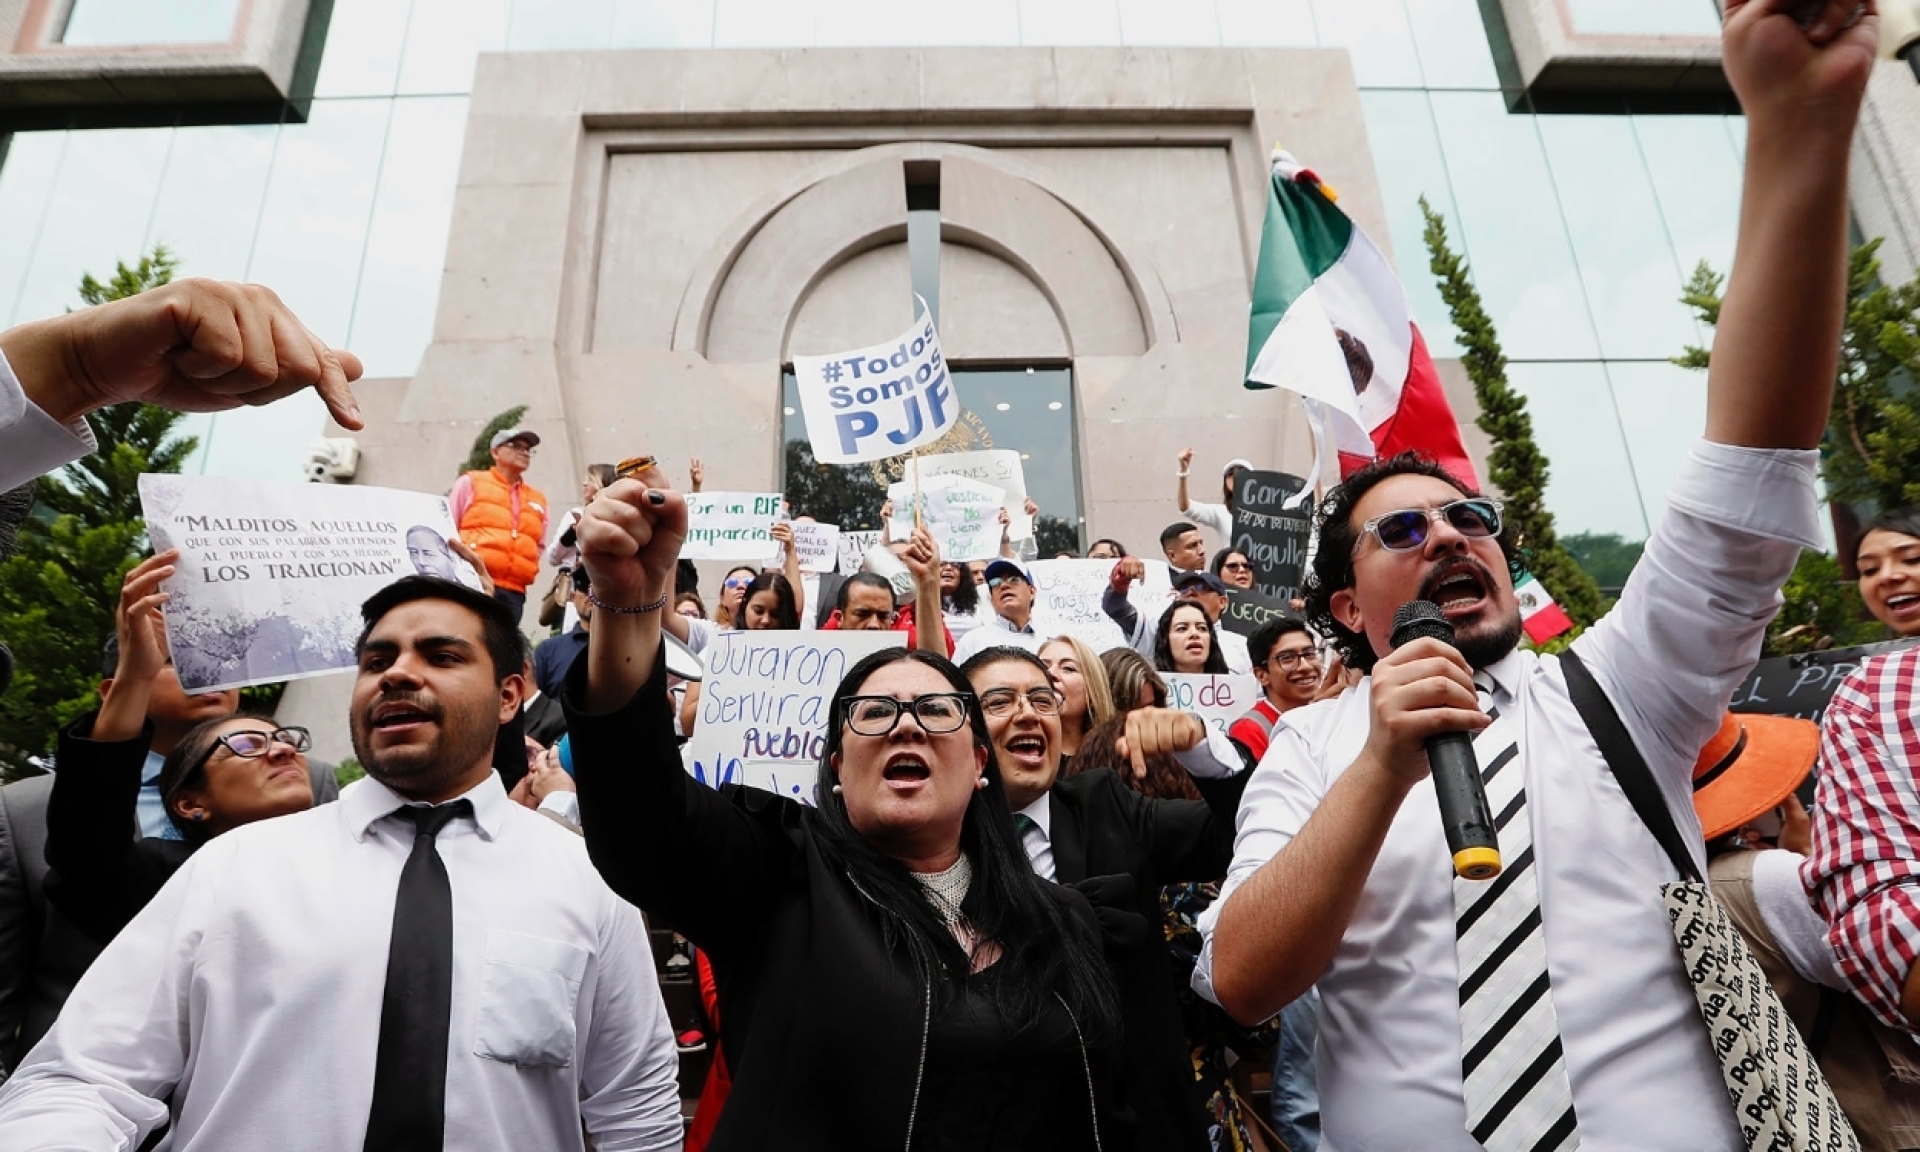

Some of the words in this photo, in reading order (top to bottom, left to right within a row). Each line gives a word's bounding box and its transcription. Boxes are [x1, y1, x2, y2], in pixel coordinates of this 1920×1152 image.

[821, 321, 933, 383] #Todos
[828, 347, 941, 409] Somos
[835, 370, 950, 456] PJF
[687, 497, 714, 515] Por
[725, 504, 744, 514] un
[310, 520, 398, 533] AQUELLOS
[684, 521, 775, 546] mparcial
[950, 521, 982, 533] tiene
[185, 537, 211, 549] QUE
[218, 537, 243, 546] CON
[249, 537, 270, 546] SUS
[275, 537, 331, 546] PALABRAS
[795, 535, 814, 545] CIAL
[817, 538, 828, 546] ES
[202, 551, 221, 562] AL
[230, 550, 283, 560] PUEBLO
[291, 550, 299, 559] Y
[303, 550, 325, 559] CON
[331, 549, 352, 558] SUS
[796, 547, 825, 557] RRERA
[203, 564, 250, 583] LOS
[711, 631, 846, 686] Juraron
[1198, 674, 1235, 707] de
